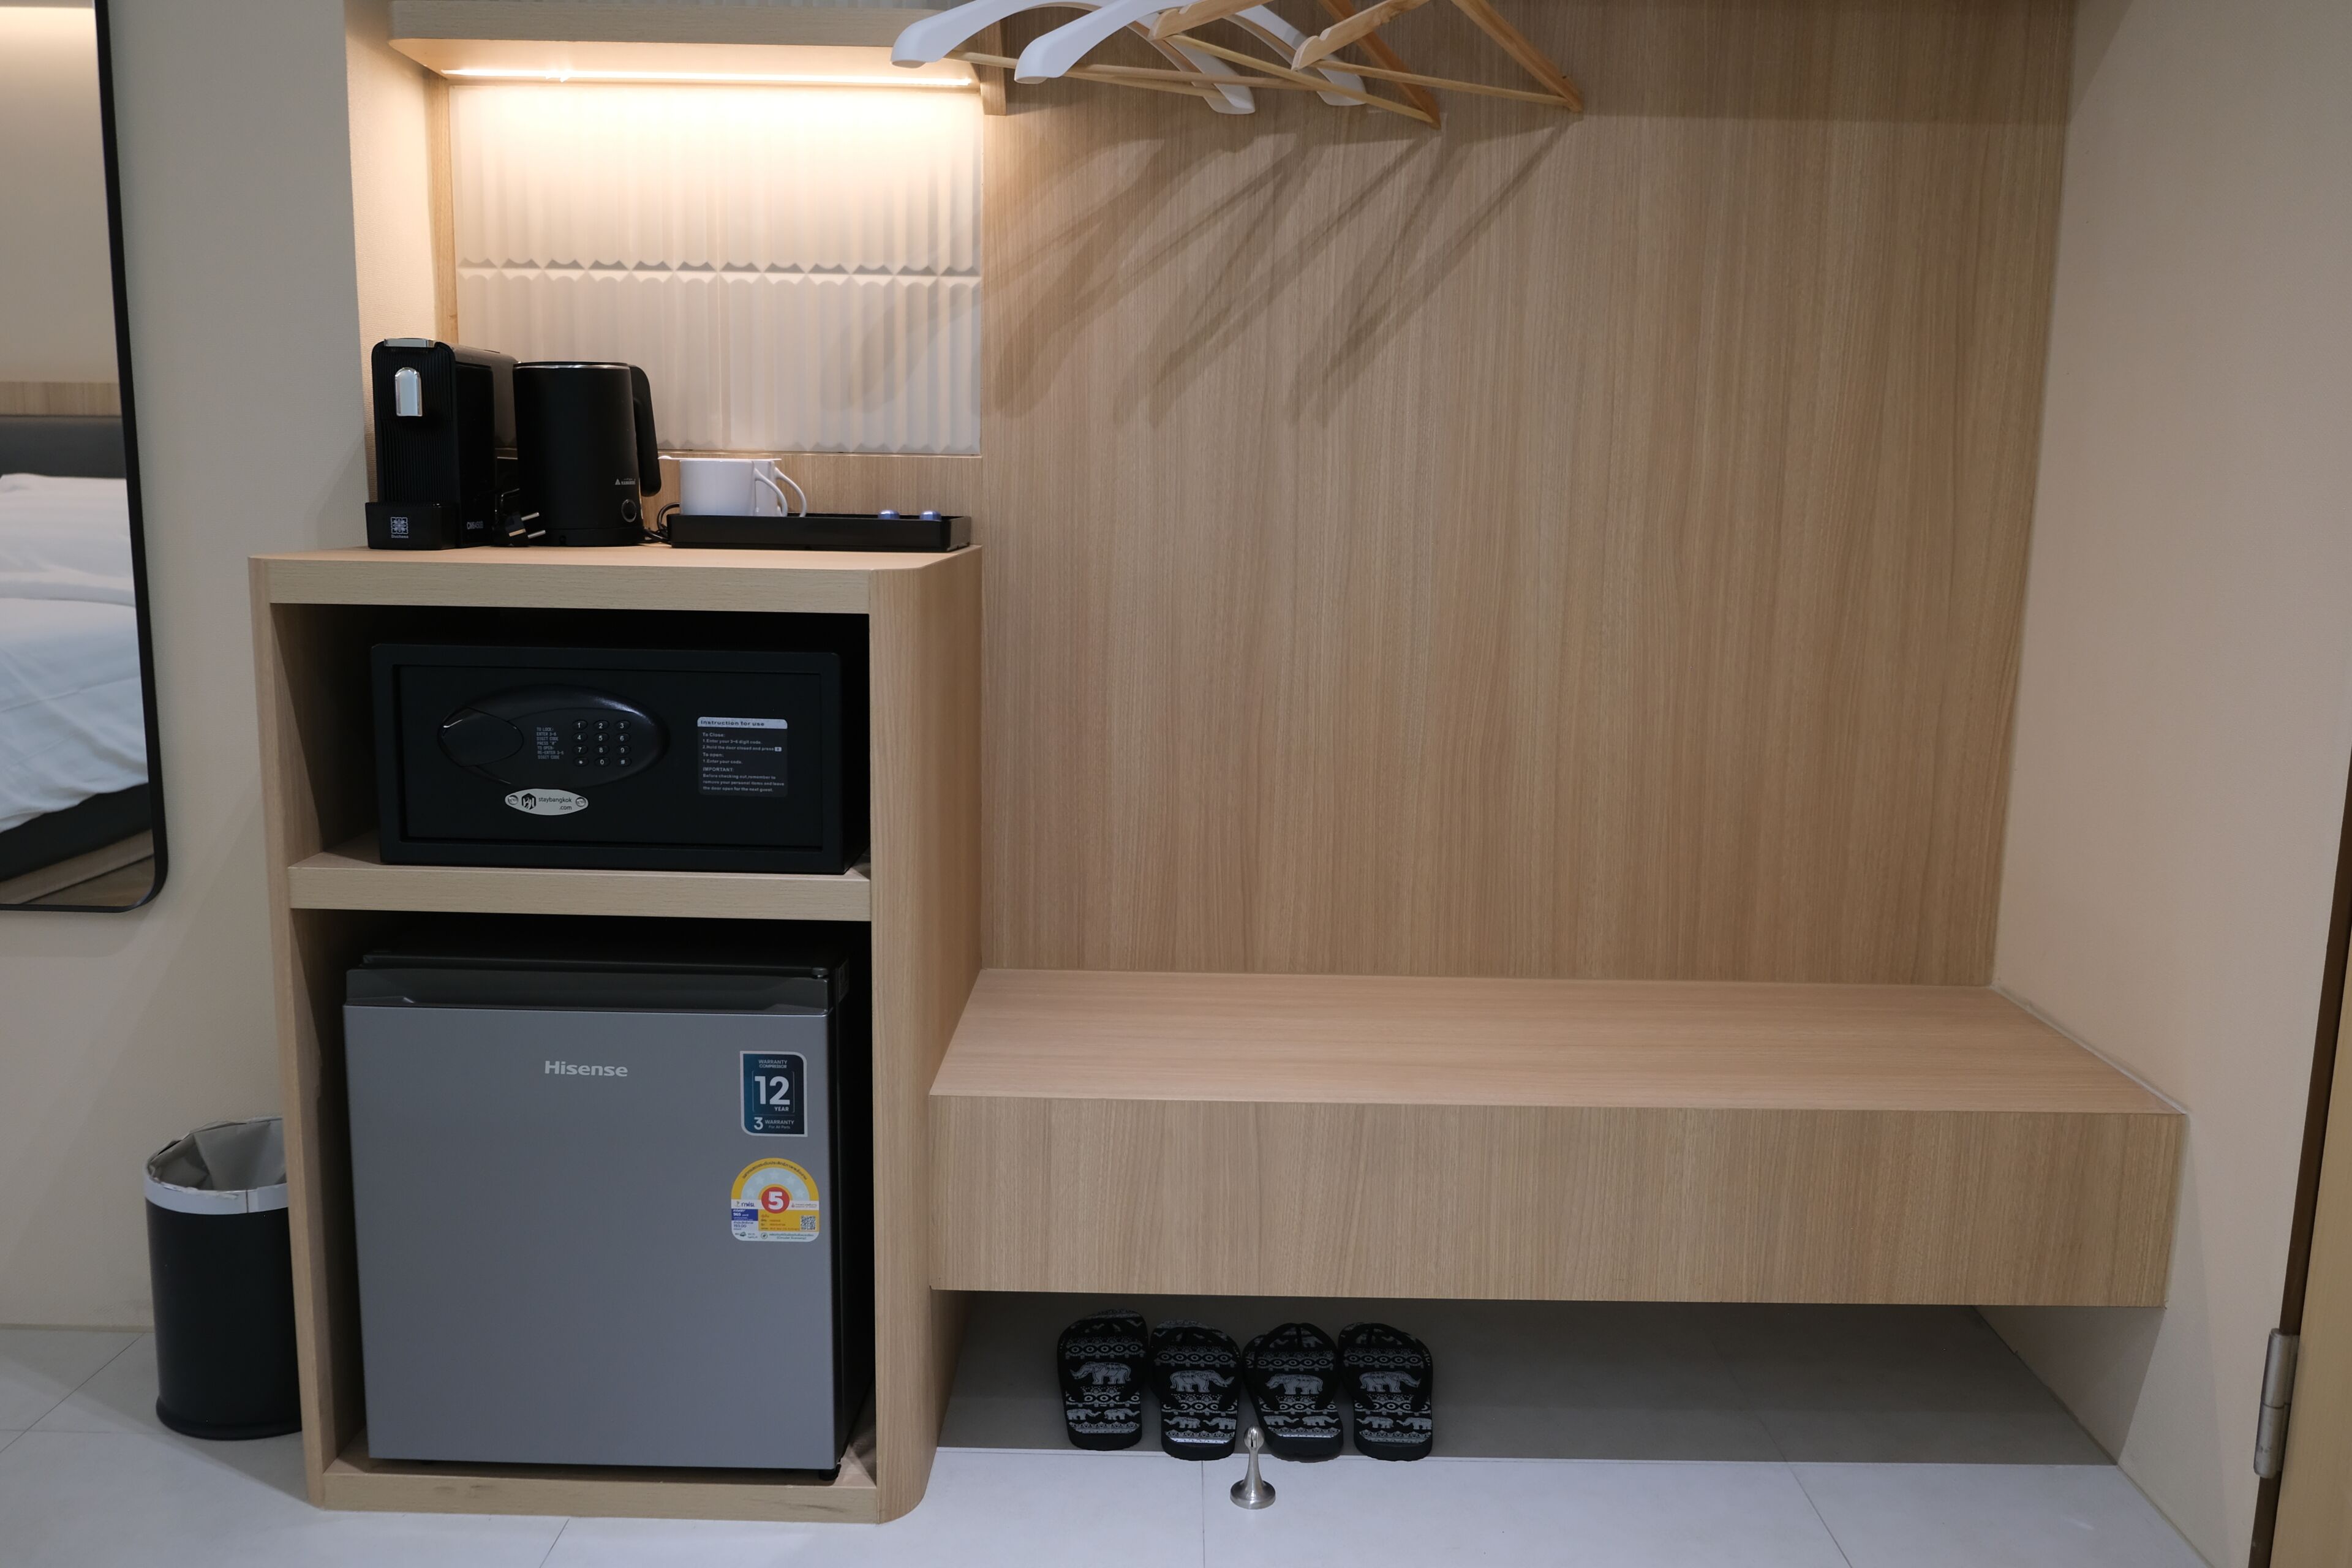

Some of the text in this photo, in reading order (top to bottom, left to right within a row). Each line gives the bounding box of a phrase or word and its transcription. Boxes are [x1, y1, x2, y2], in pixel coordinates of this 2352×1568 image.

[545, 1060, 628, 1077] Hisense
[755, 1076, 790, 1105] 12
[754, 1117, 763, 1130] 3
[768, 1191, 784, 1210] 5
